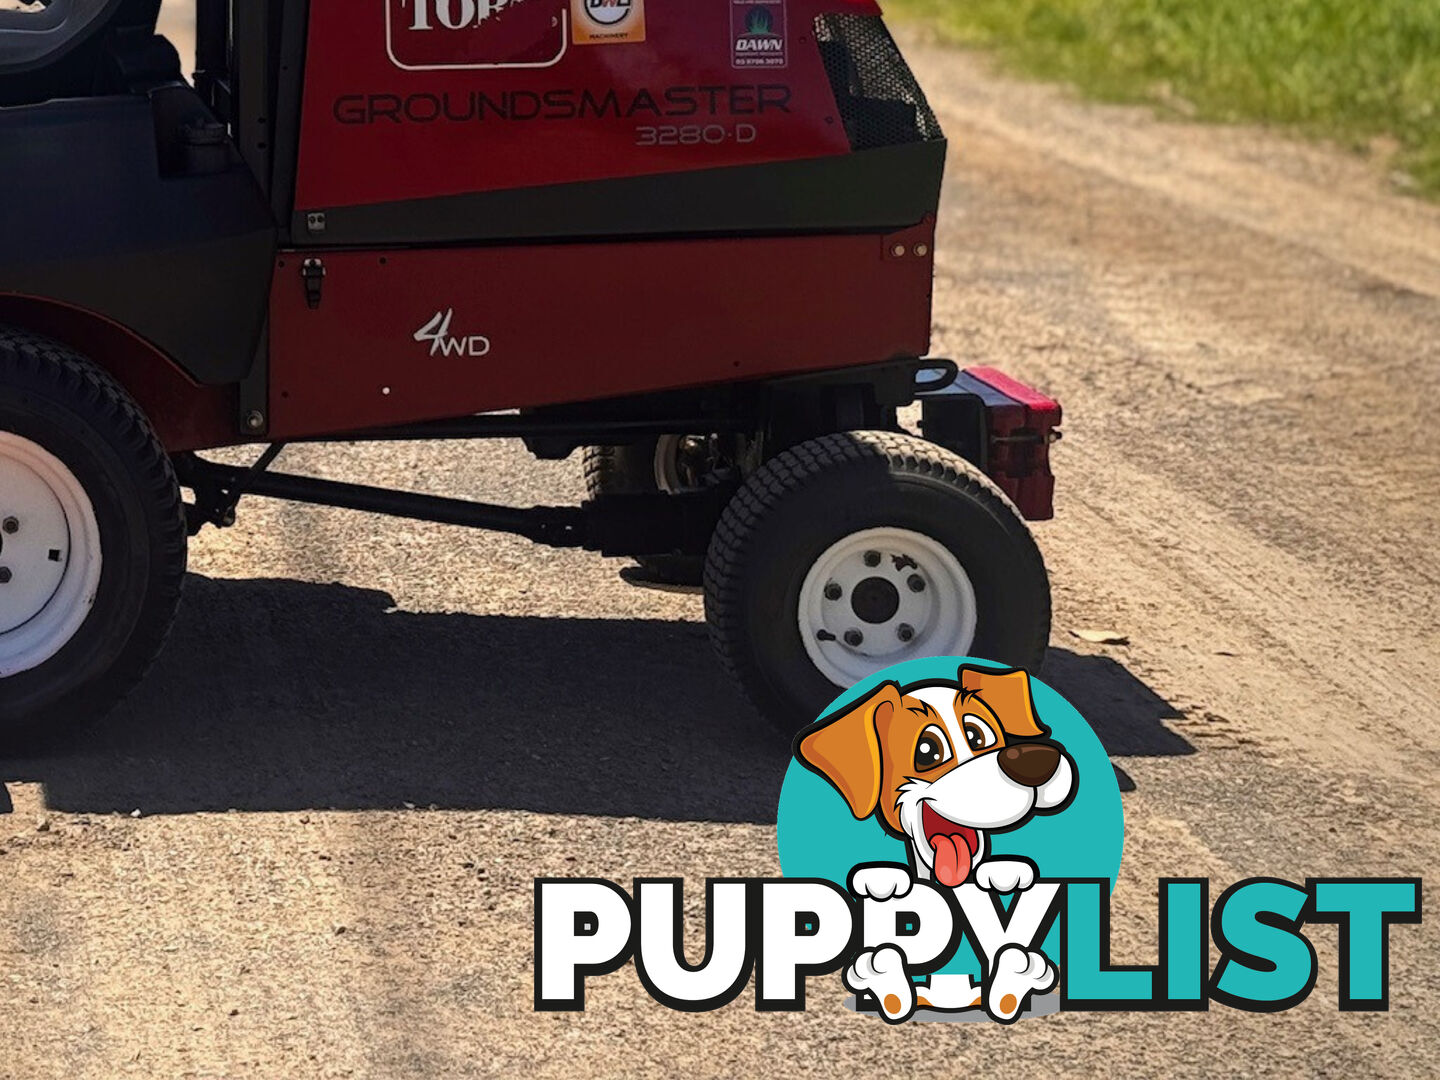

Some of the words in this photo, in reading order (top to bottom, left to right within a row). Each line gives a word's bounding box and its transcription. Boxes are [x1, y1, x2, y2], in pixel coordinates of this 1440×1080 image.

[735, 38, 784, 51] DAWN
[332, 84, 793, 124] GROUNDSMASTER
[413, 307, 490, 357] 4WD
